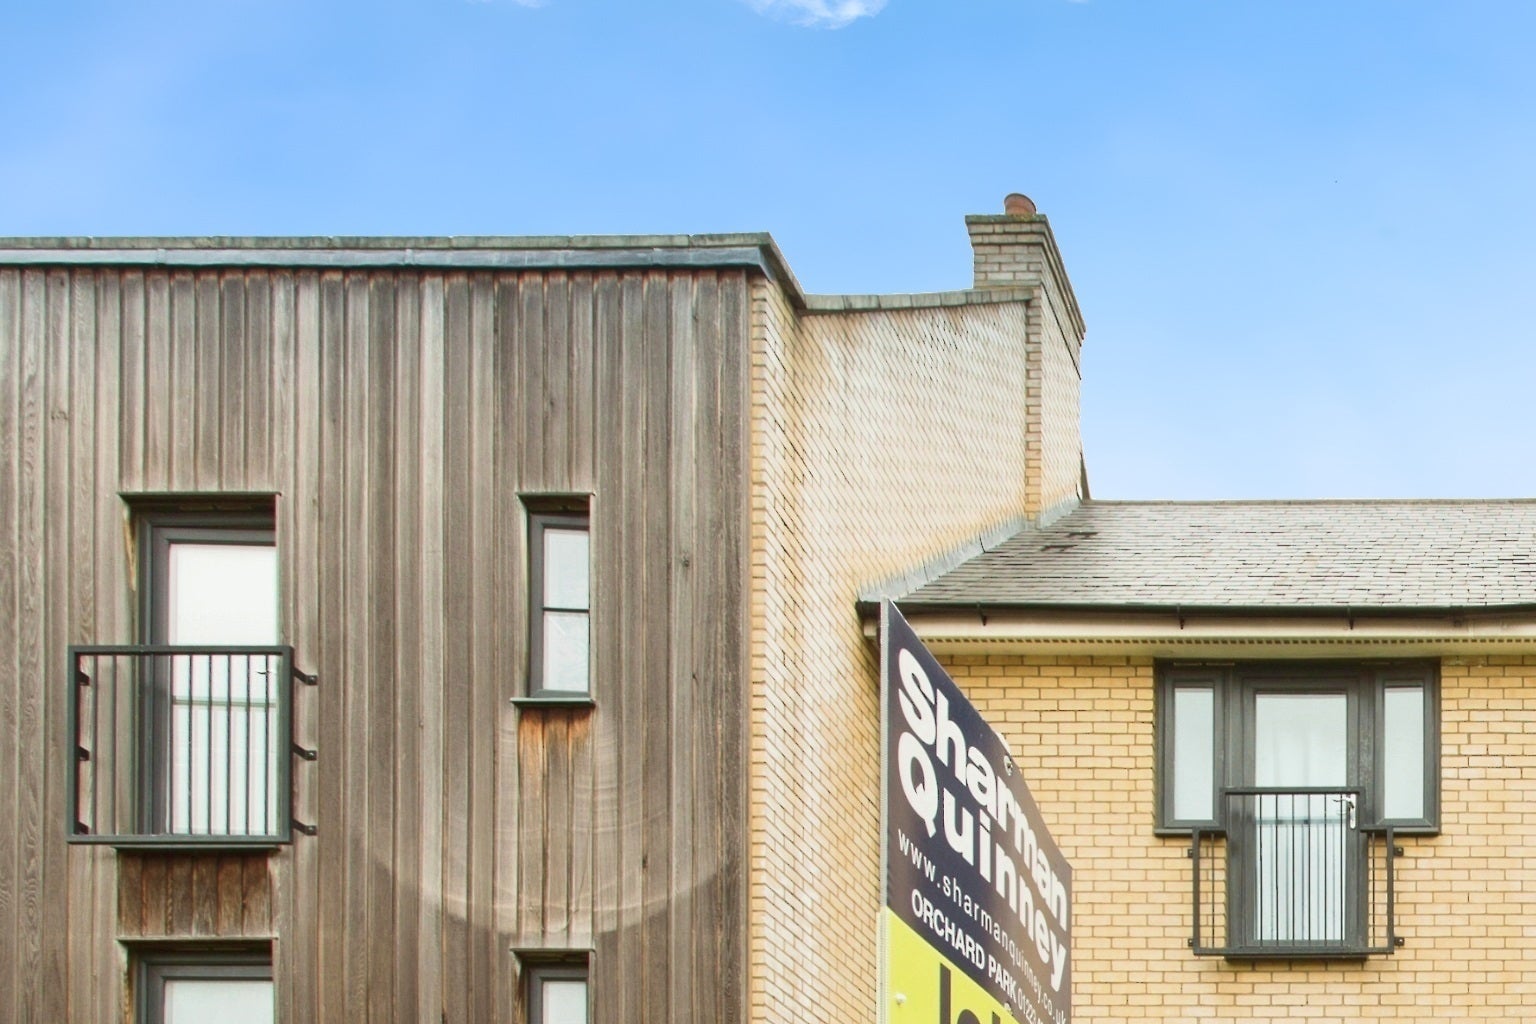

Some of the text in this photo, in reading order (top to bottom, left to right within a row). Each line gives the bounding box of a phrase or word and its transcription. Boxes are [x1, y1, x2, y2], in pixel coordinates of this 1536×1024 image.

[897, 731, 1067, 992] Quinney
[898, 648, 1068, 932] Sharman
[911, 888, 986, 970] ORCHARD
[988, 955, 1017, 1003] PARK
